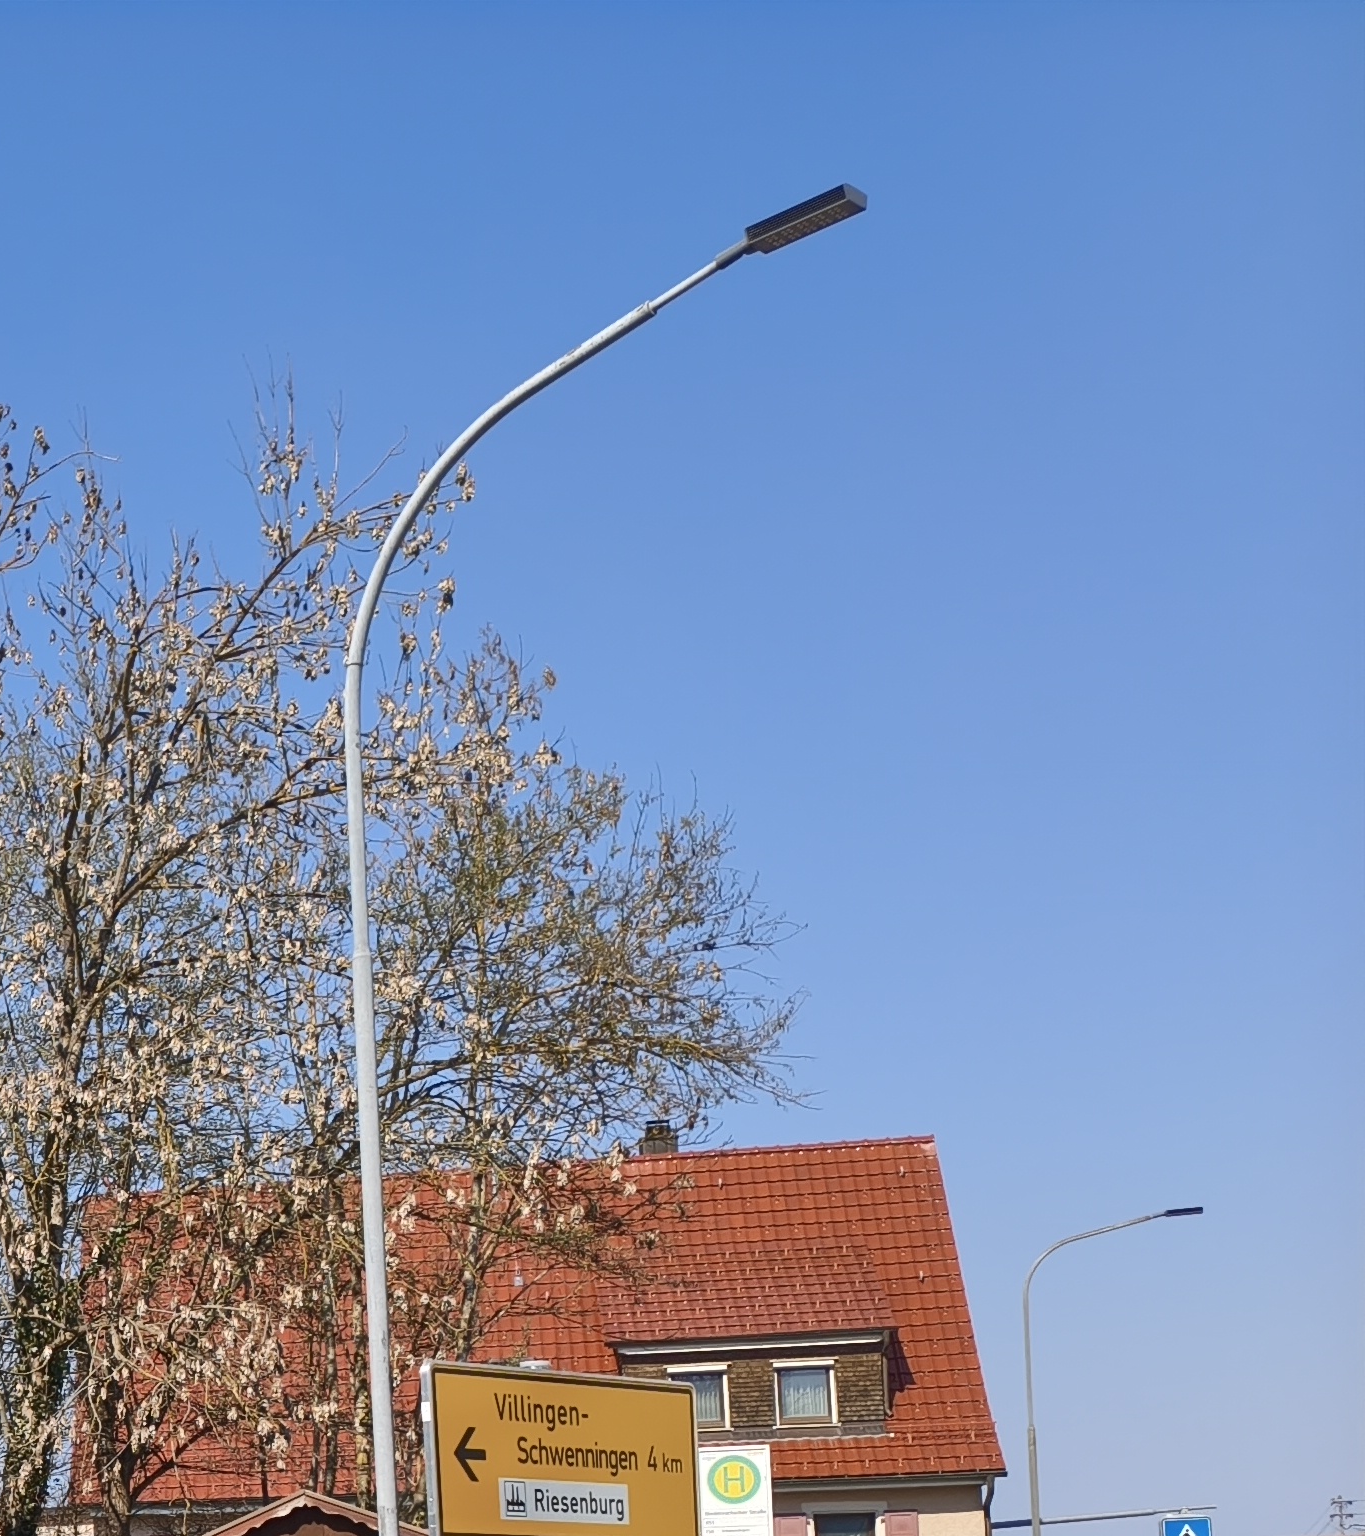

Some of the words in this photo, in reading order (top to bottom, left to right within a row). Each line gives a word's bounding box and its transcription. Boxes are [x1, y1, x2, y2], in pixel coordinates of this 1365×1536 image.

[494, 1392, 589, 1432] Villingen-
[516, 1436, 639, 1477] Schwenningen
[647, 1445, 658, 1472] 4
[662, 1452, 683, 1474] km
[723, 1465, 746, 1493] H
[534, 1488, 625, 1522] Riesenburg
